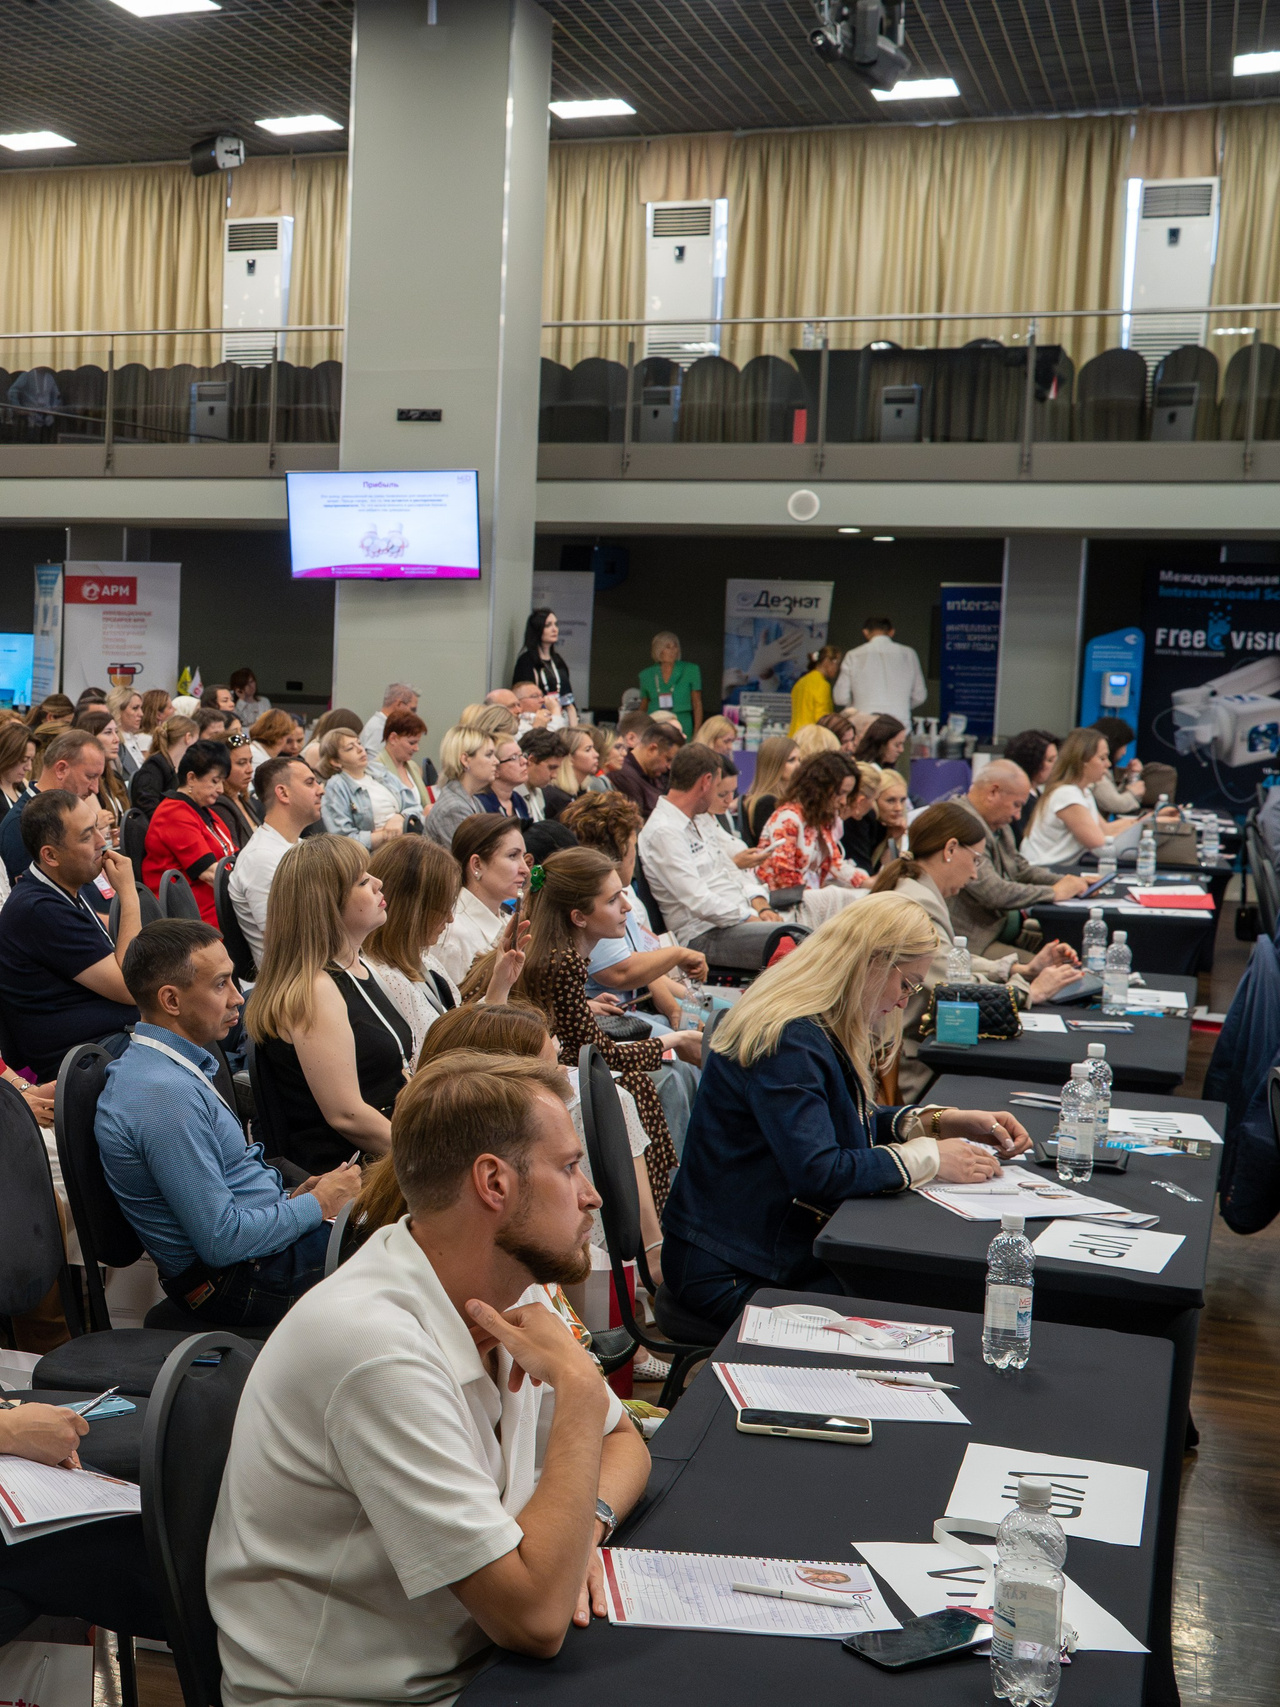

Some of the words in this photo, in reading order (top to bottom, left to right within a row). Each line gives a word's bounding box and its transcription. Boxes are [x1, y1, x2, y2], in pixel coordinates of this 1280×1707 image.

[363, 481, 399, 489] Прибыль
[1160, 569, 1280, 587] Международная
[101, 584, 130, 597] АРМ
[1158, 585, 1261, 600] International
[753, 590, 822, 616] Дезнэт
[1155, 627, 1207, 649] Free
[1129, 1116, 1183, 1134] VIP
[1068, 1233, 1139, 1259] VIP
